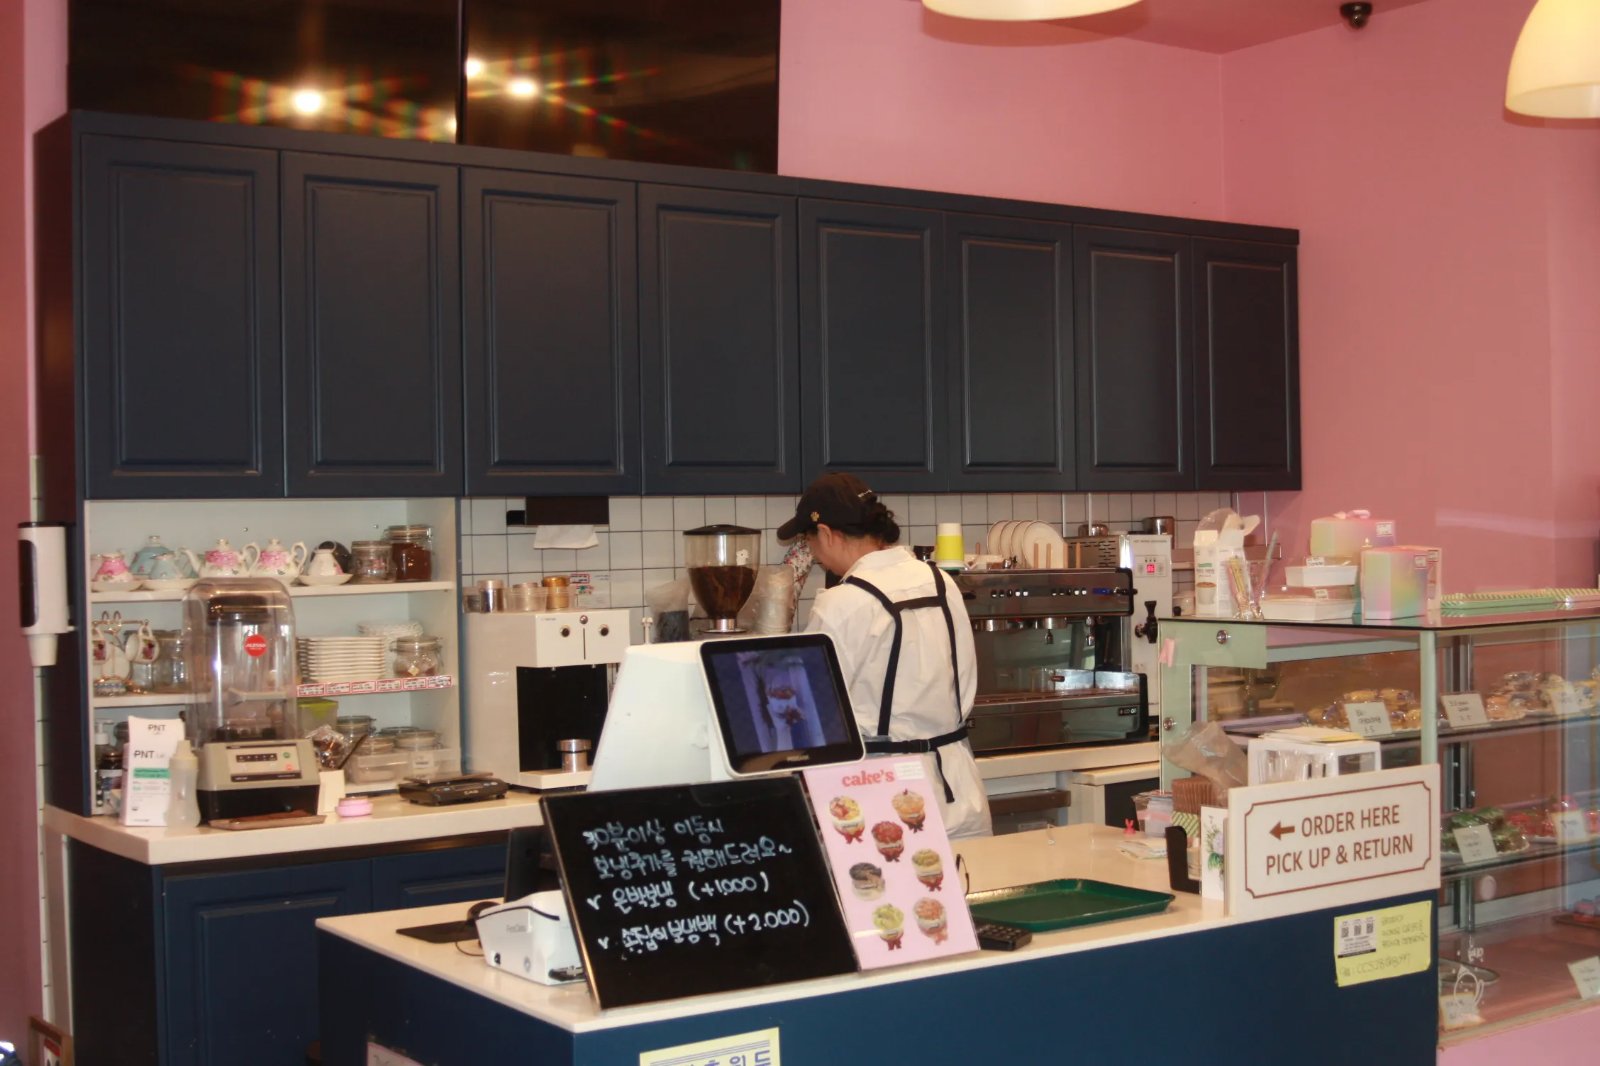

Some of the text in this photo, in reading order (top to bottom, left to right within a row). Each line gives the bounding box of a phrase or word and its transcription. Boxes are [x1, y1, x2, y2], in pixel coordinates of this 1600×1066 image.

[134, 750, 154, 759] PNT
[842, 769, 895, 788] cake's
[674, 815, 725, 844] 이동시
[1301, 804, 1401, 838] ORDER HERE
[596, 849, 677, 880] 보냉추가를
[1266, 834, 1414, 876] PICK UP & RETURN
[612, 880, 677, 915] 은박보냉
